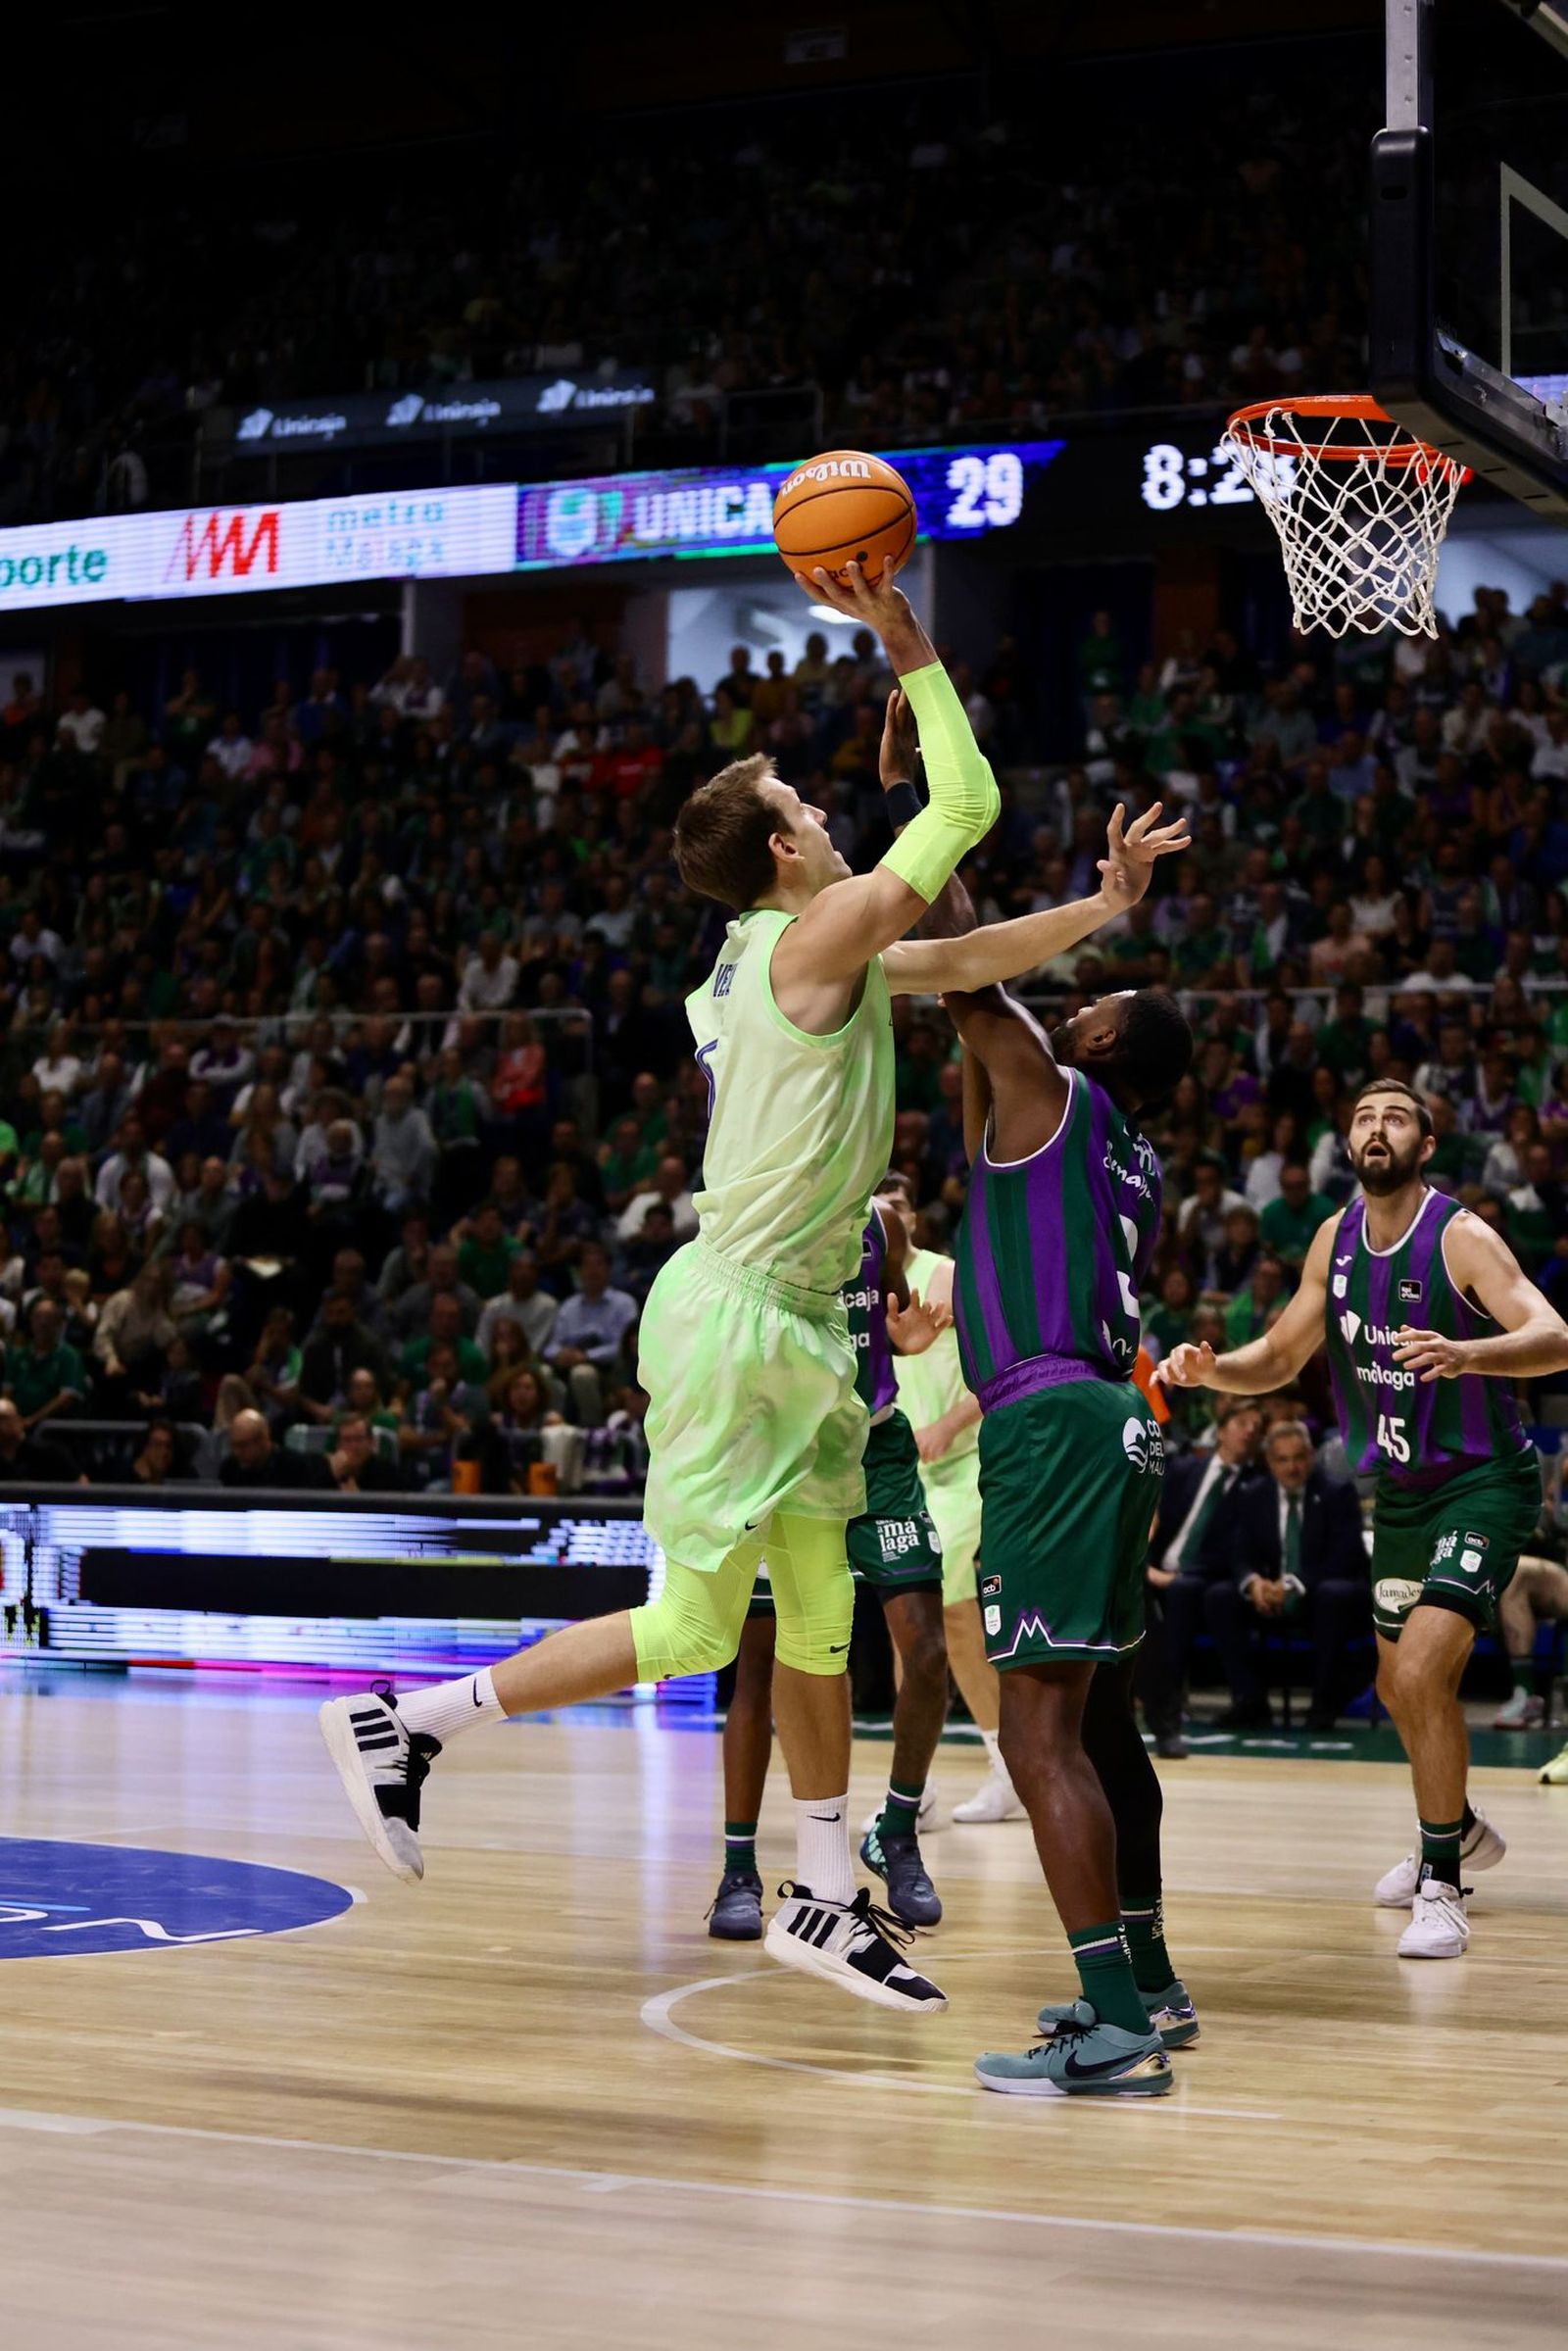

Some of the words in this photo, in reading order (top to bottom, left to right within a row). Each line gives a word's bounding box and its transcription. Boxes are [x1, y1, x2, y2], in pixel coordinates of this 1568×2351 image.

[781, 460, 871, 496] Wilson
[948, 453, 1023, 527] 29
[840, 1286, 880, 1312] caja
[1363, 1324, 1416, 1347] Unic
[1377, 1413, 1411, 1463] 45
[883, 1516, 918, 1538] má
[879, 1533, 920, 1553] laga
